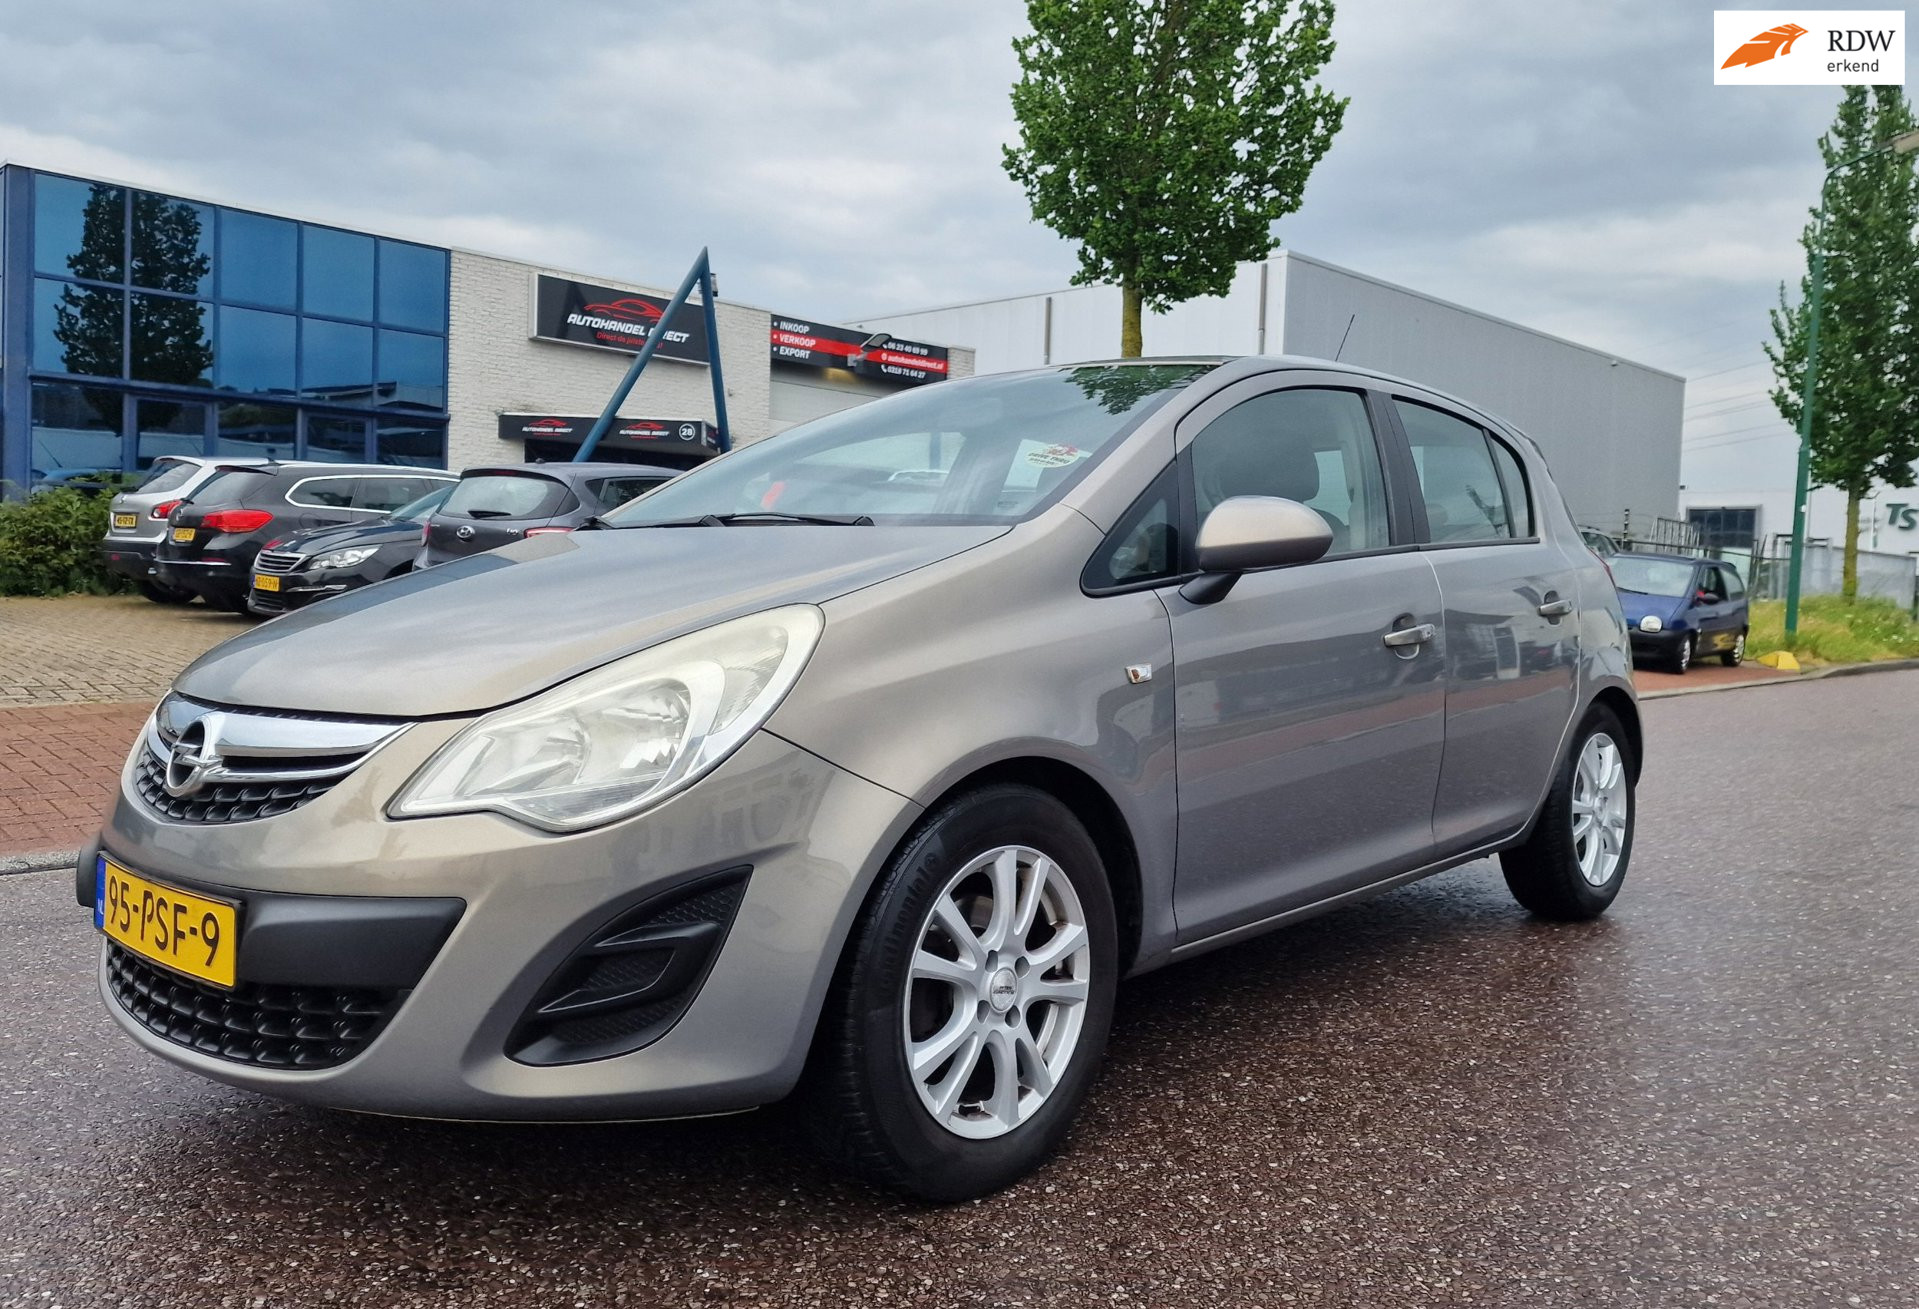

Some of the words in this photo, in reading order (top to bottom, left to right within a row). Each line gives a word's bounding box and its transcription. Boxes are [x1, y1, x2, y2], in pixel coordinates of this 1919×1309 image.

[567, 313, 646, 336] AUTOHANDEL
[779, 321, 810, 334] INKOOP
[779, 334, 816, 347] VERKOOP
[779, 346, 810, 359] EXPORT
[682, 429, 693, 437] 28
[109, 875, 220, 967] 95-PSF-9
